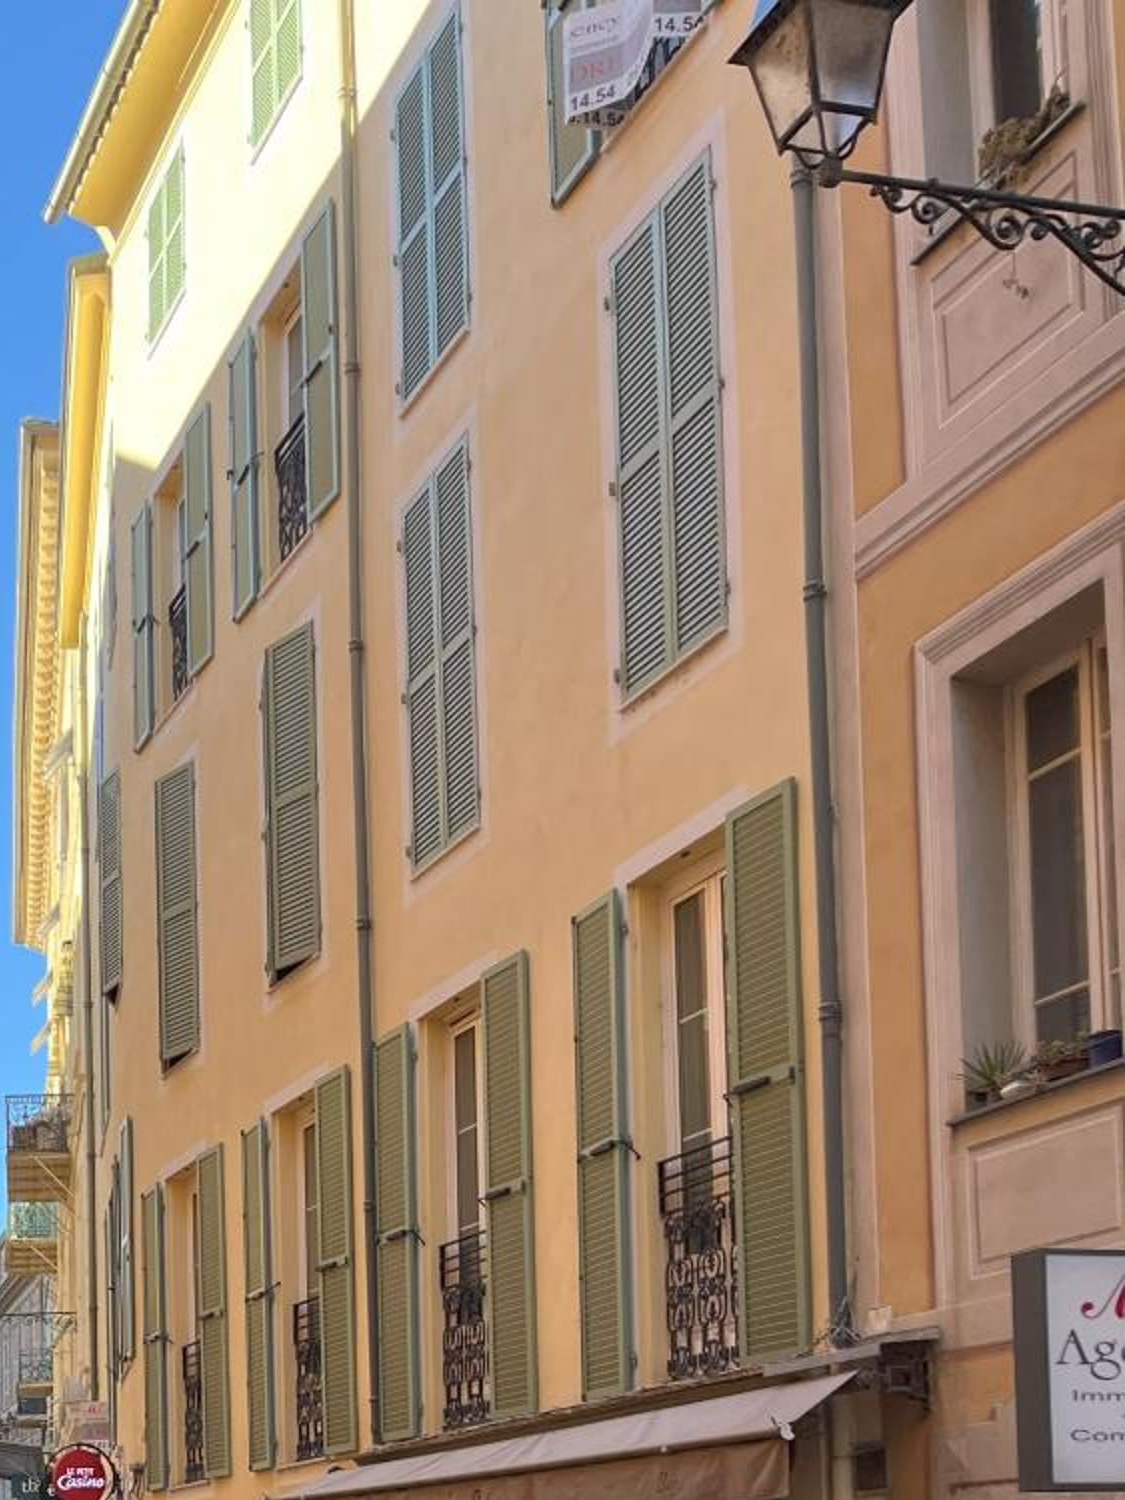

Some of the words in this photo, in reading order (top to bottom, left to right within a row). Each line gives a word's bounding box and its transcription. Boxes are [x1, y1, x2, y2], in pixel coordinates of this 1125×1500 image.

[571, 84, 616, 111] 14.54
[1055, 1328, 1125, 1381] Ag
[56, 1474, 105, 1491] Casino
